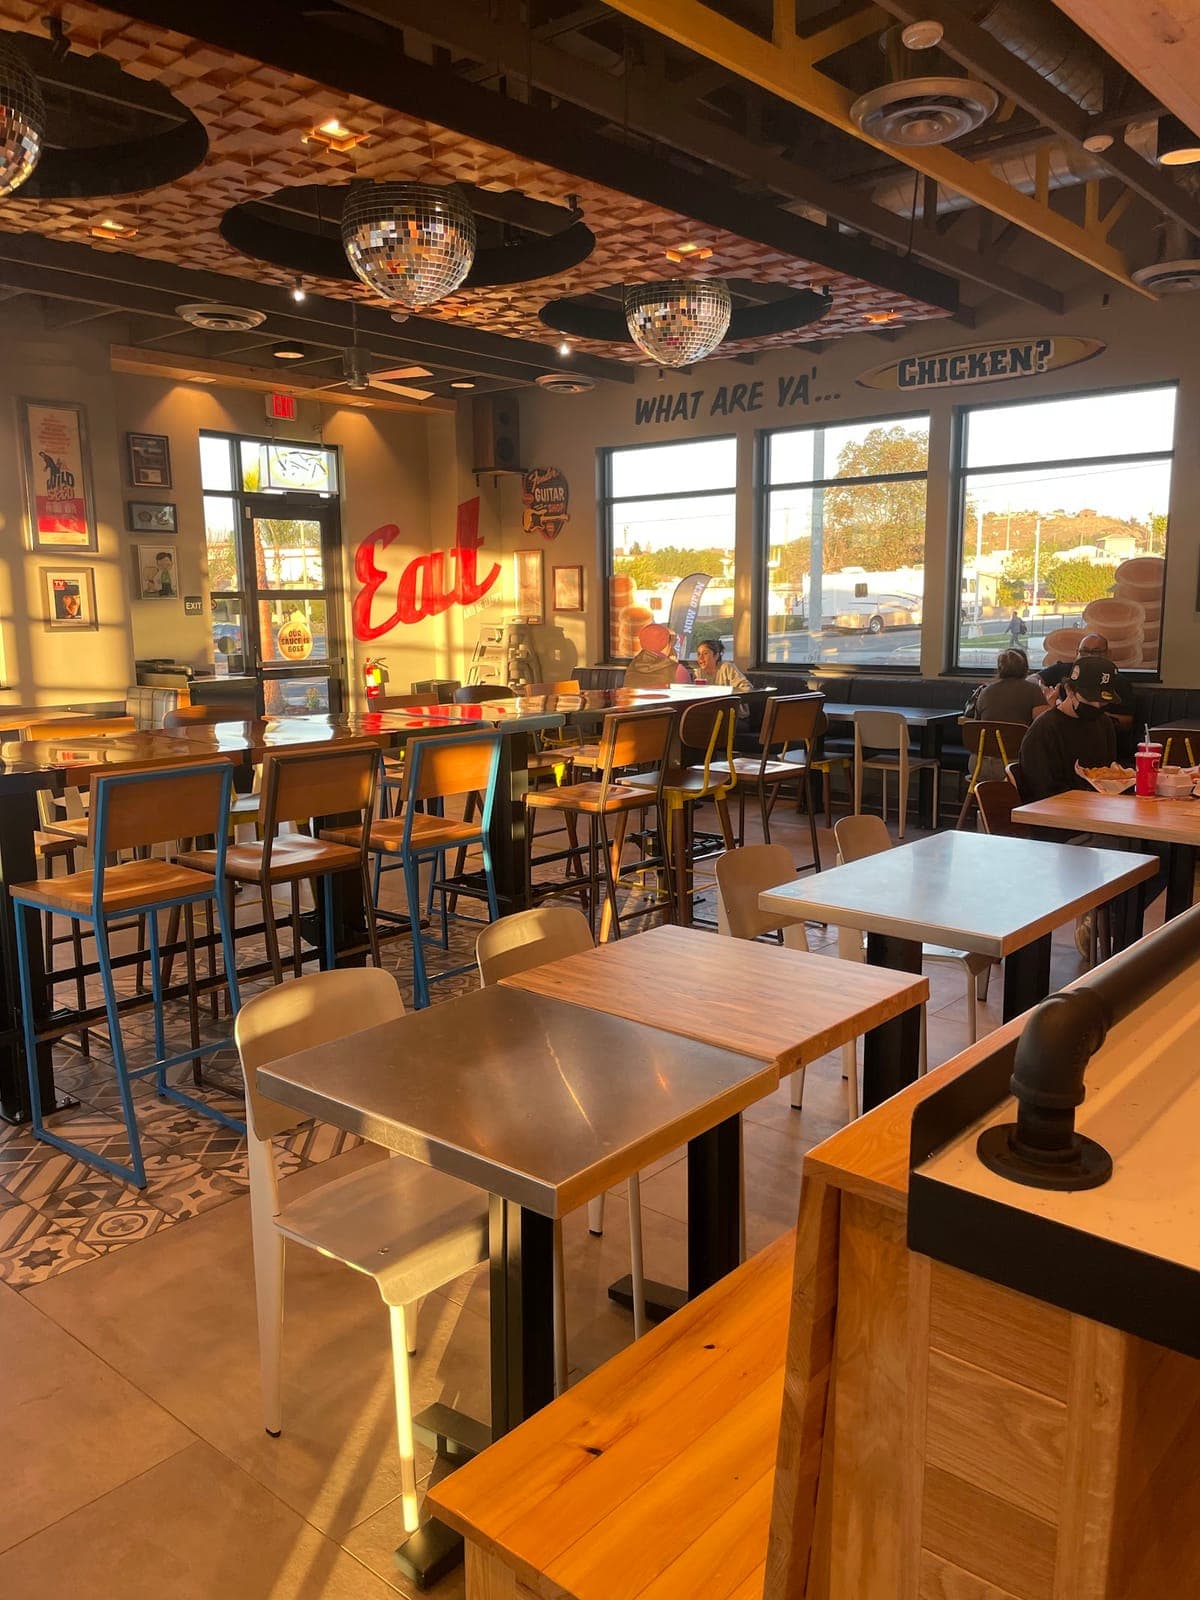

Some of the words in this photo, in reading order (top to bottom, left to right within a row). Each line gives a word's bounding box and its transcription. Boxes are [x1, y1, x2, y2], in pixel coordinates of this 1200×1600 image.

[898, 339, 1052, 387] CHICKEN?
[273, 394, 294, 418] EXIT
[635, 391, 704, 425] WHAT
[710, 382, 764, 416] ARE
[534, 487, 565, 502] GUITAR
[352, 496, 502, 641] Eat
[185, 602, 201, 610] EXIT
[683, 609, 697, 634] NOW
[690, 582, 705, 608] OPEN
